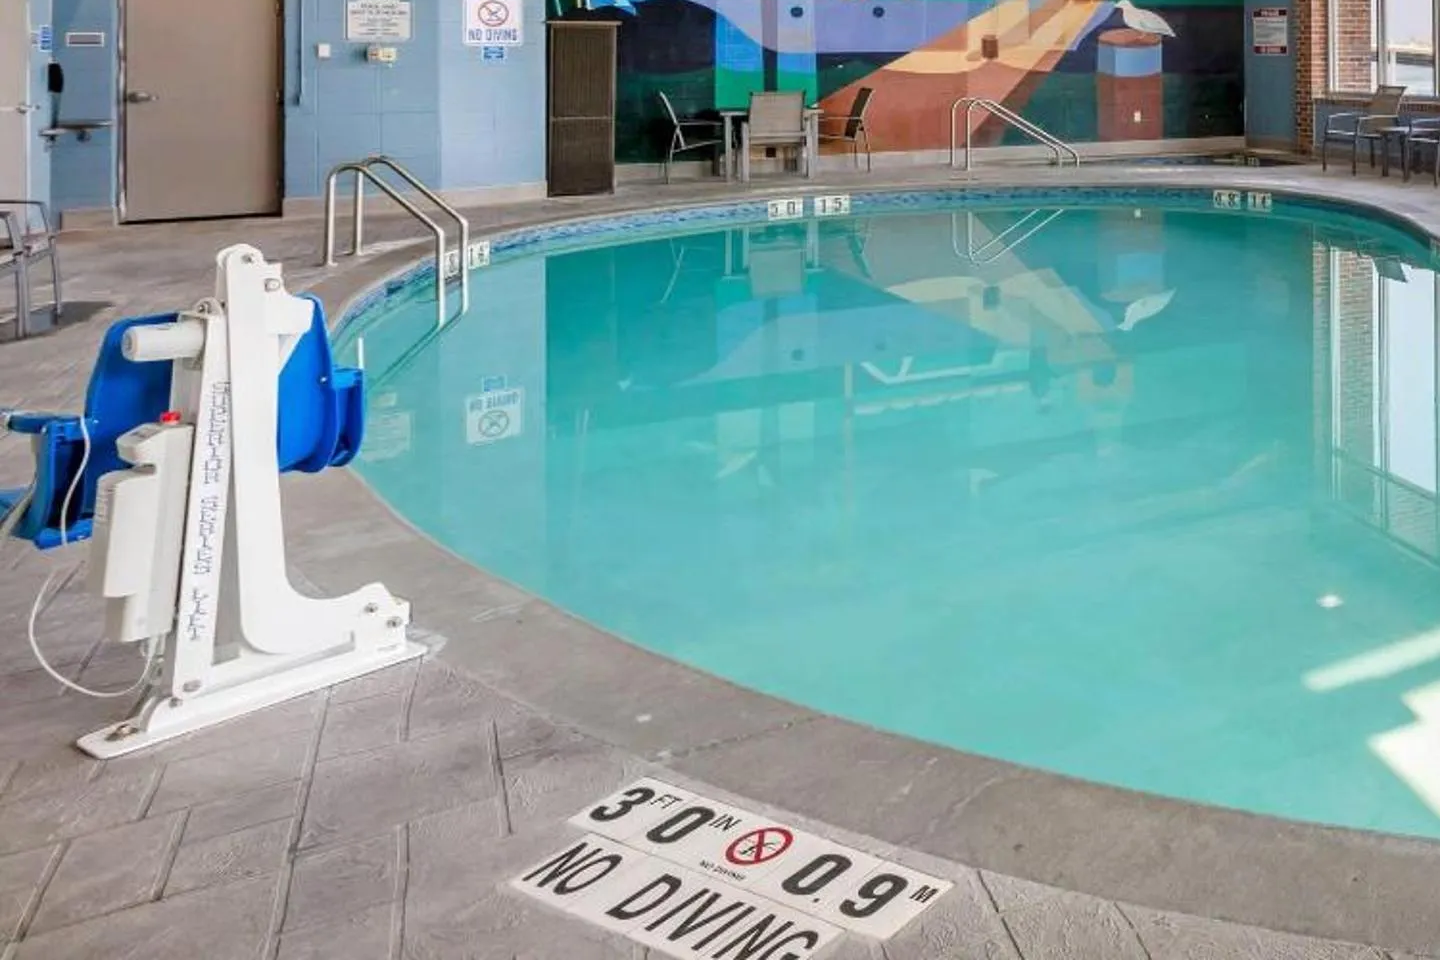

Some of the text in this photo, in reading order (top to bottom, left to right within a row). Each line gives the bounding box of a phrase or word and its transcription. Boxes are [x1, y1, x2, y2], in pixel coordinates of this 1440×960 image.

[468, 28, 517, 41] NO DIVING
[522, 842, 820, 960] NO DIVING
